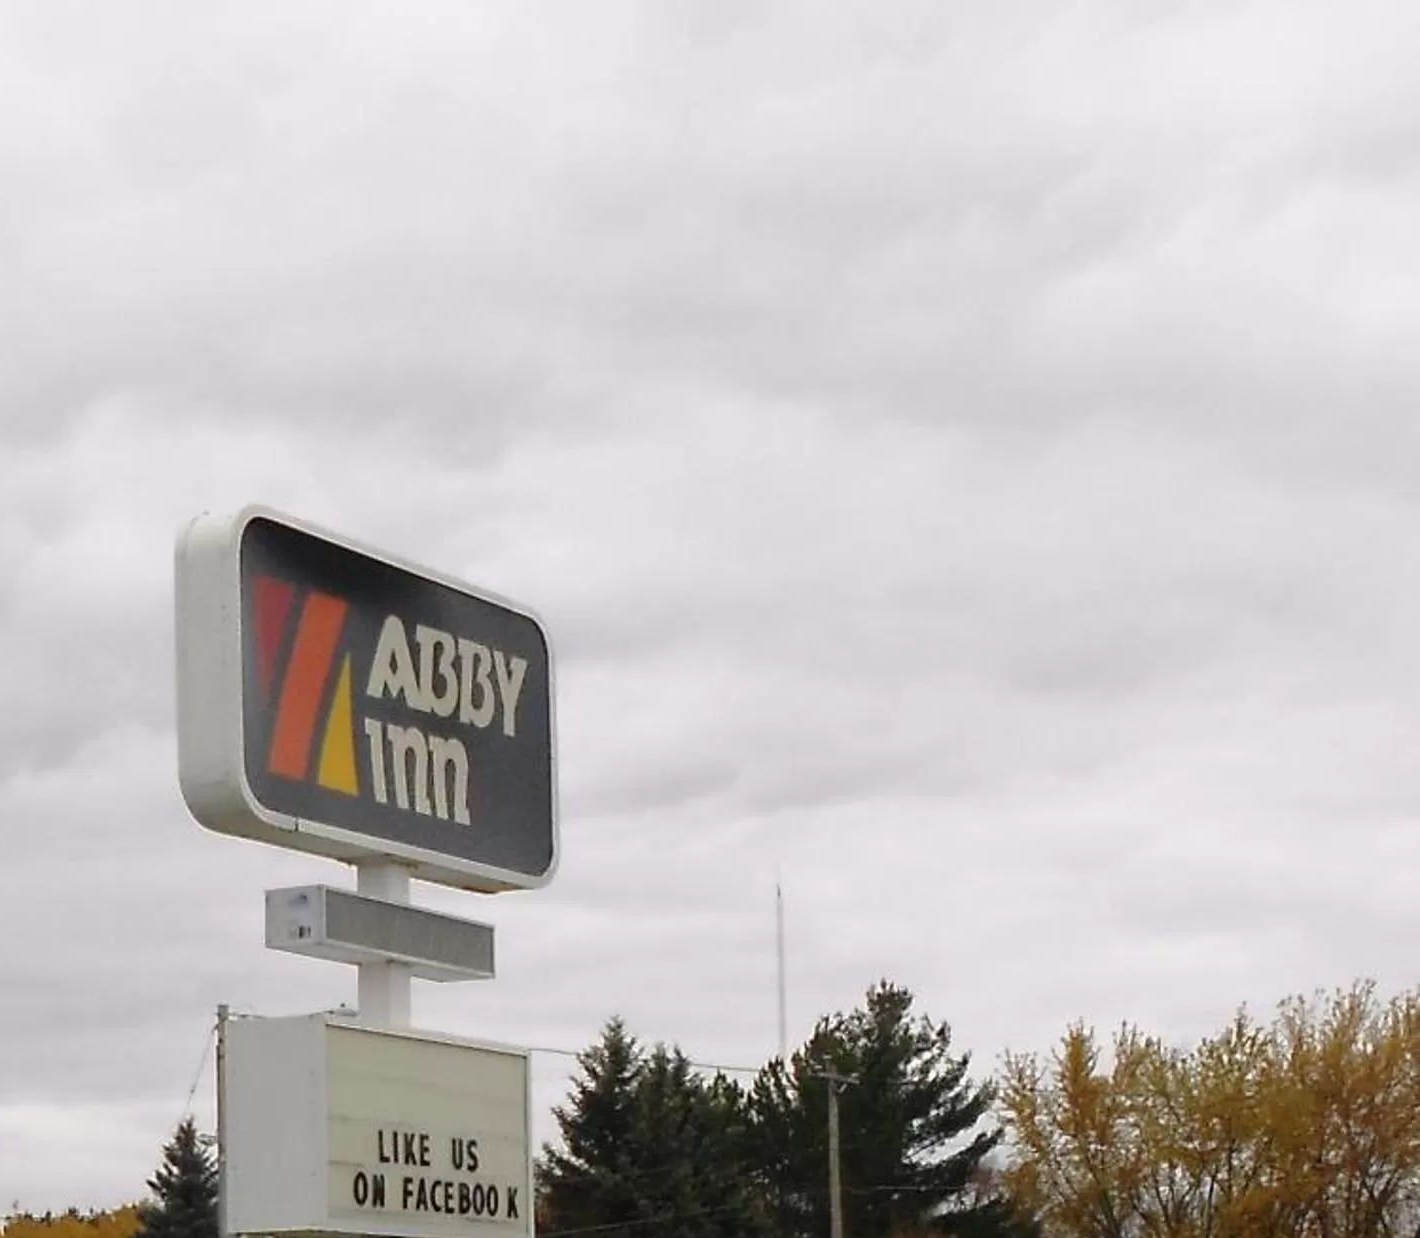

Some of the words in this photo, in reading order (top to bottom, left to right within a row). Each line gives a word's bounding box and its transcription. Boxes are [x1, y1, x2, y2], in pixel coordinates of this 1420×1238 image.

[366, 614, 528, 737] ABBY
[377, 1129, 431, 1167] LIKE
[451, 1138, 479, 1172] US
[352, 1171, 386, 1209] ON
[402, 1177, 519, 1219] FACEBOOK
